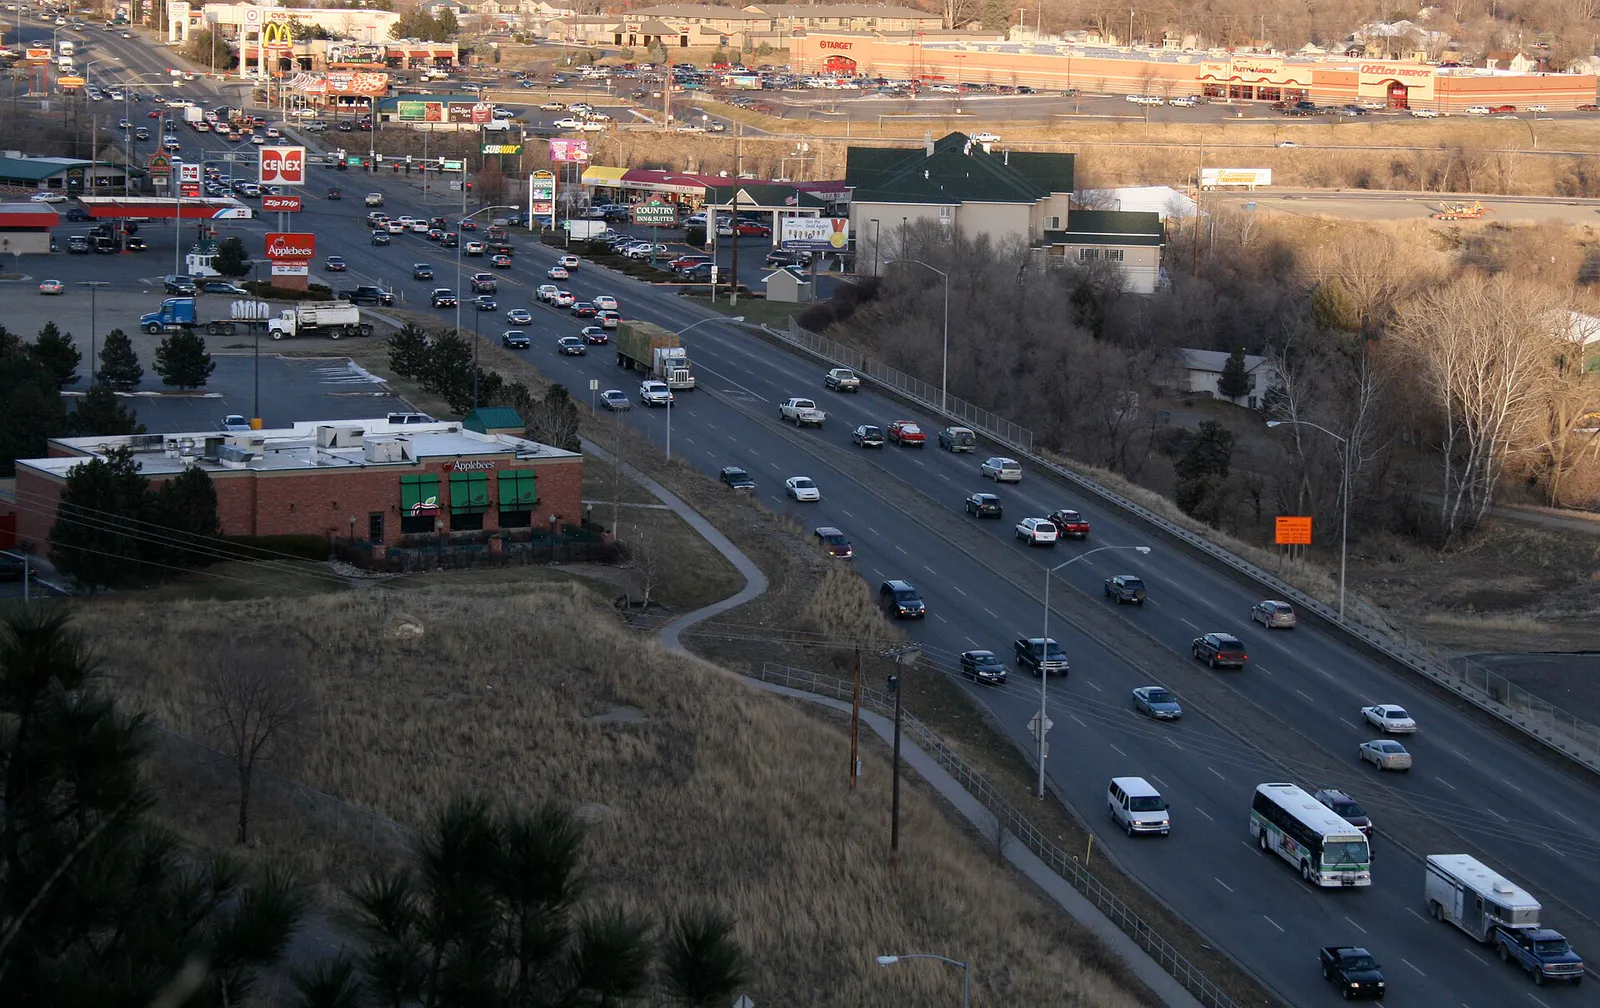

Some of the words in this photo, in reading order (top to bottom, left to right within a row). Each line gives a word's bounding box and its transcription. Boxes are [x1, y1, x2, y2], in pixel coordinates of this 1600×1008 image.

[827, 41, 853, 50] TARGET
[1254, 67, 1278, 75] AMERICA
[1360, 65, 1397, 75] Office
[1397, 69, 1432, 77] DEPOT
[482, 145, 520, 154] SUBWAY
[262, 159, 301, 171] CENEX
[636, 206, 675, 214] COUNTRY
[268, 245, 312, 256] Applebee's
[453, 460, 495, 471] Applebee's
